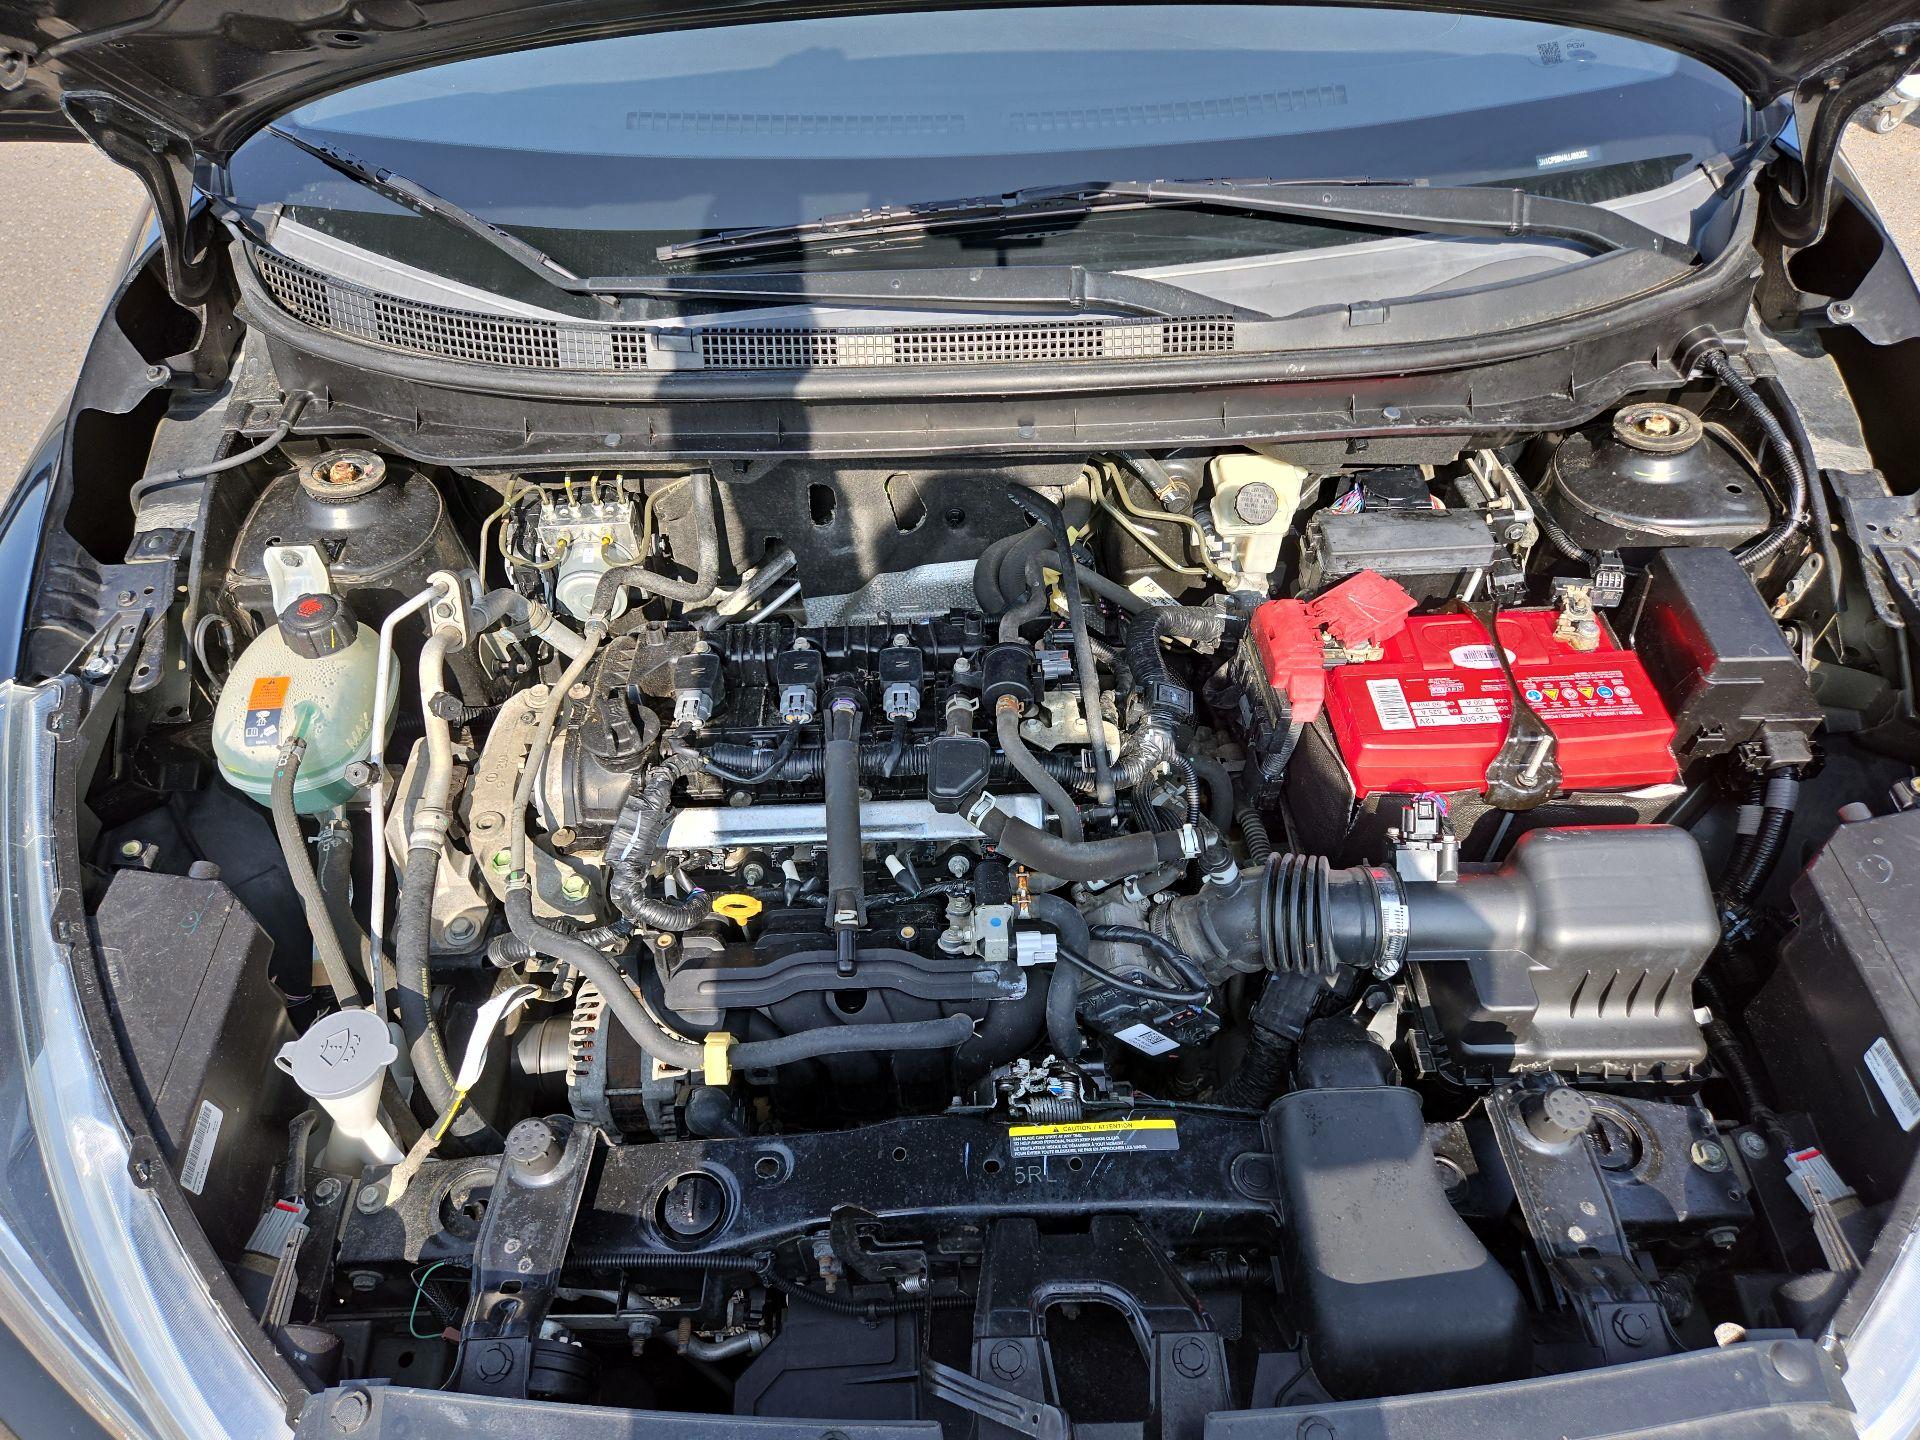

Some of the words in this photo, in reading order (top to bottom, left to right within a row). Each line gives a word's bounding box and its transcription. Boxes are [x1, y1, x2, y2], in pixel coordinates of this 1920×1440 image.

[1418, 717, 1436, 725] 12V
[1098, 1122, 1133, 1130] ATTENTION
[1014, 1165, 1057, 1184] 5RL
